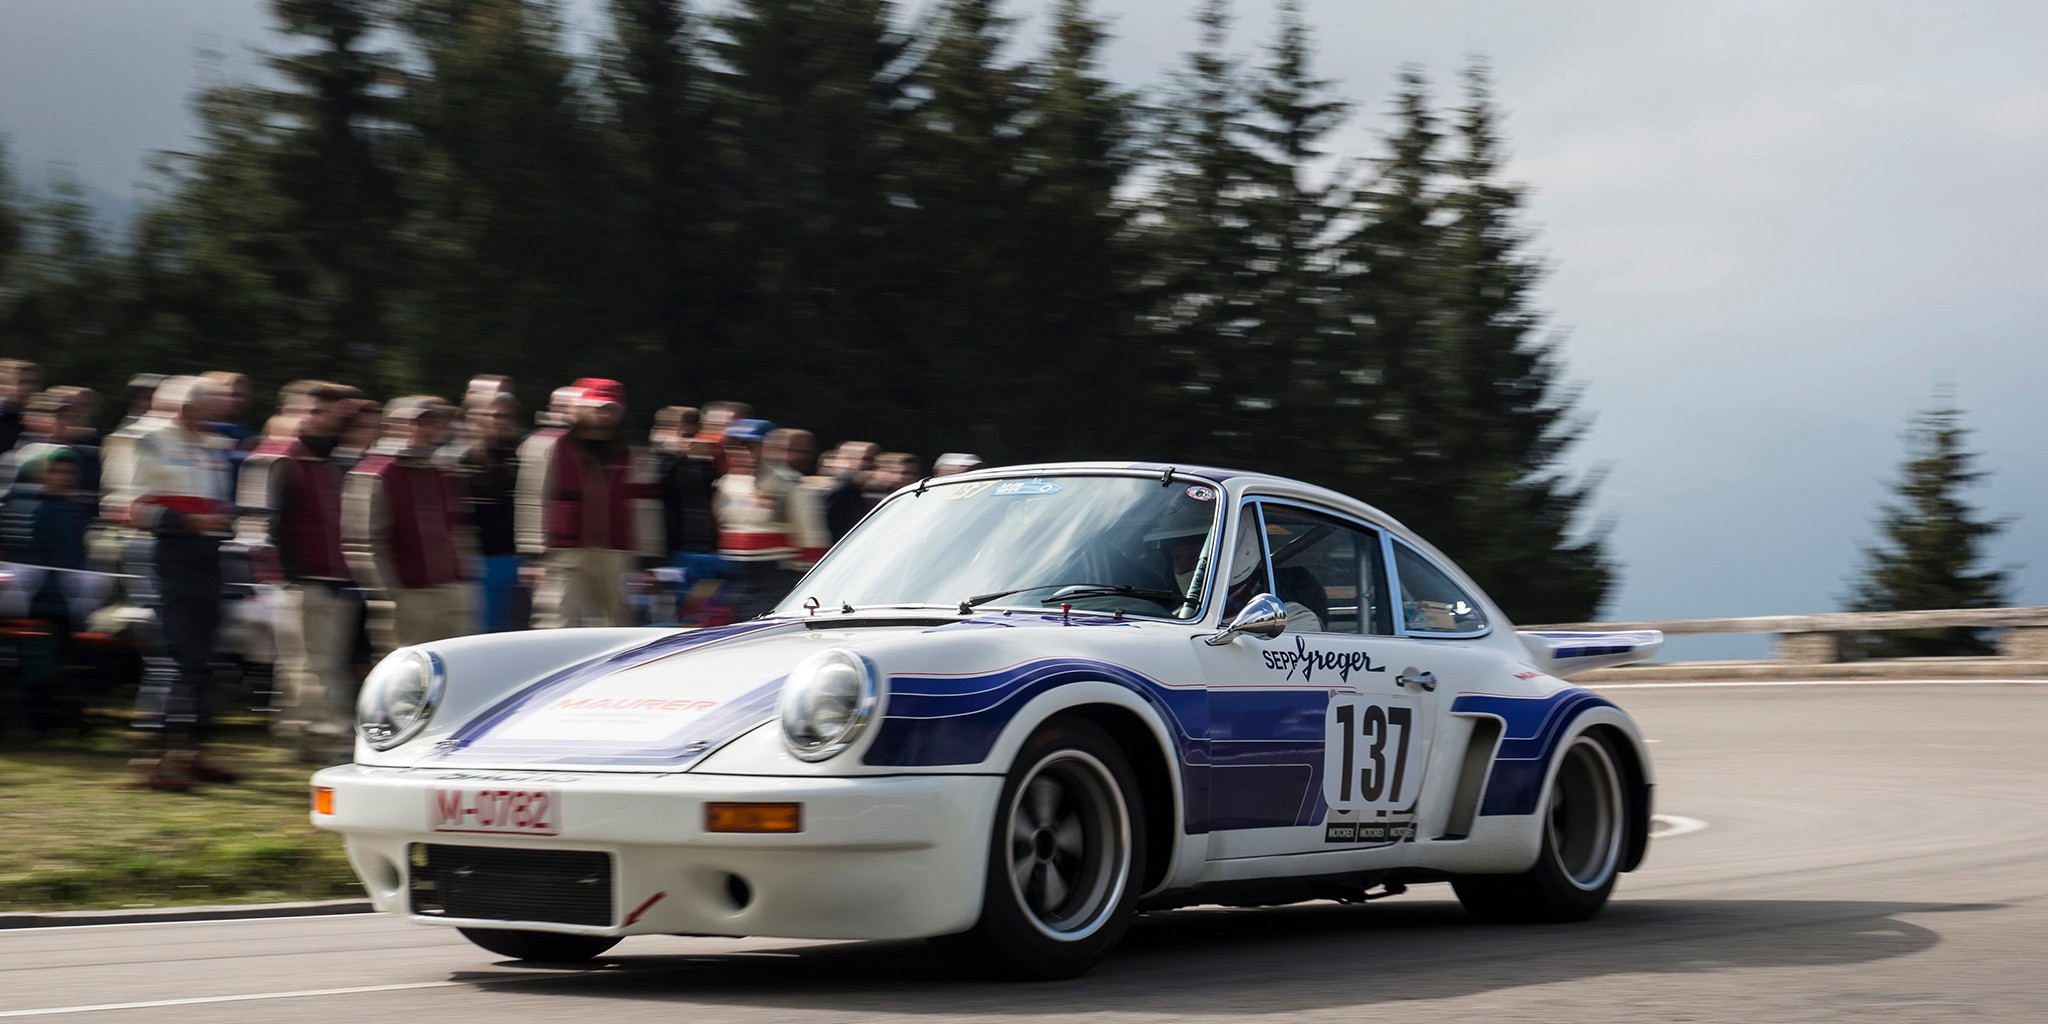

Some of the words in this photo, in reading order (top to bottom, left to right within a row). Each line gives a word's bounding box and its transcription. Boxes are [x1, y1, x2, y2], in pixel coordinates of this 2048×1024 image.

[1262, 650, 1299, 670] SEPP
[1287, 635, 1386, 683] Greger
[549, 698, 718, 711] MAURER
[1336, 704, 1412, 802] 137
[436, 789, 549, 828] M-0782
[1328, 828, 1354, 838] MOTOREX
